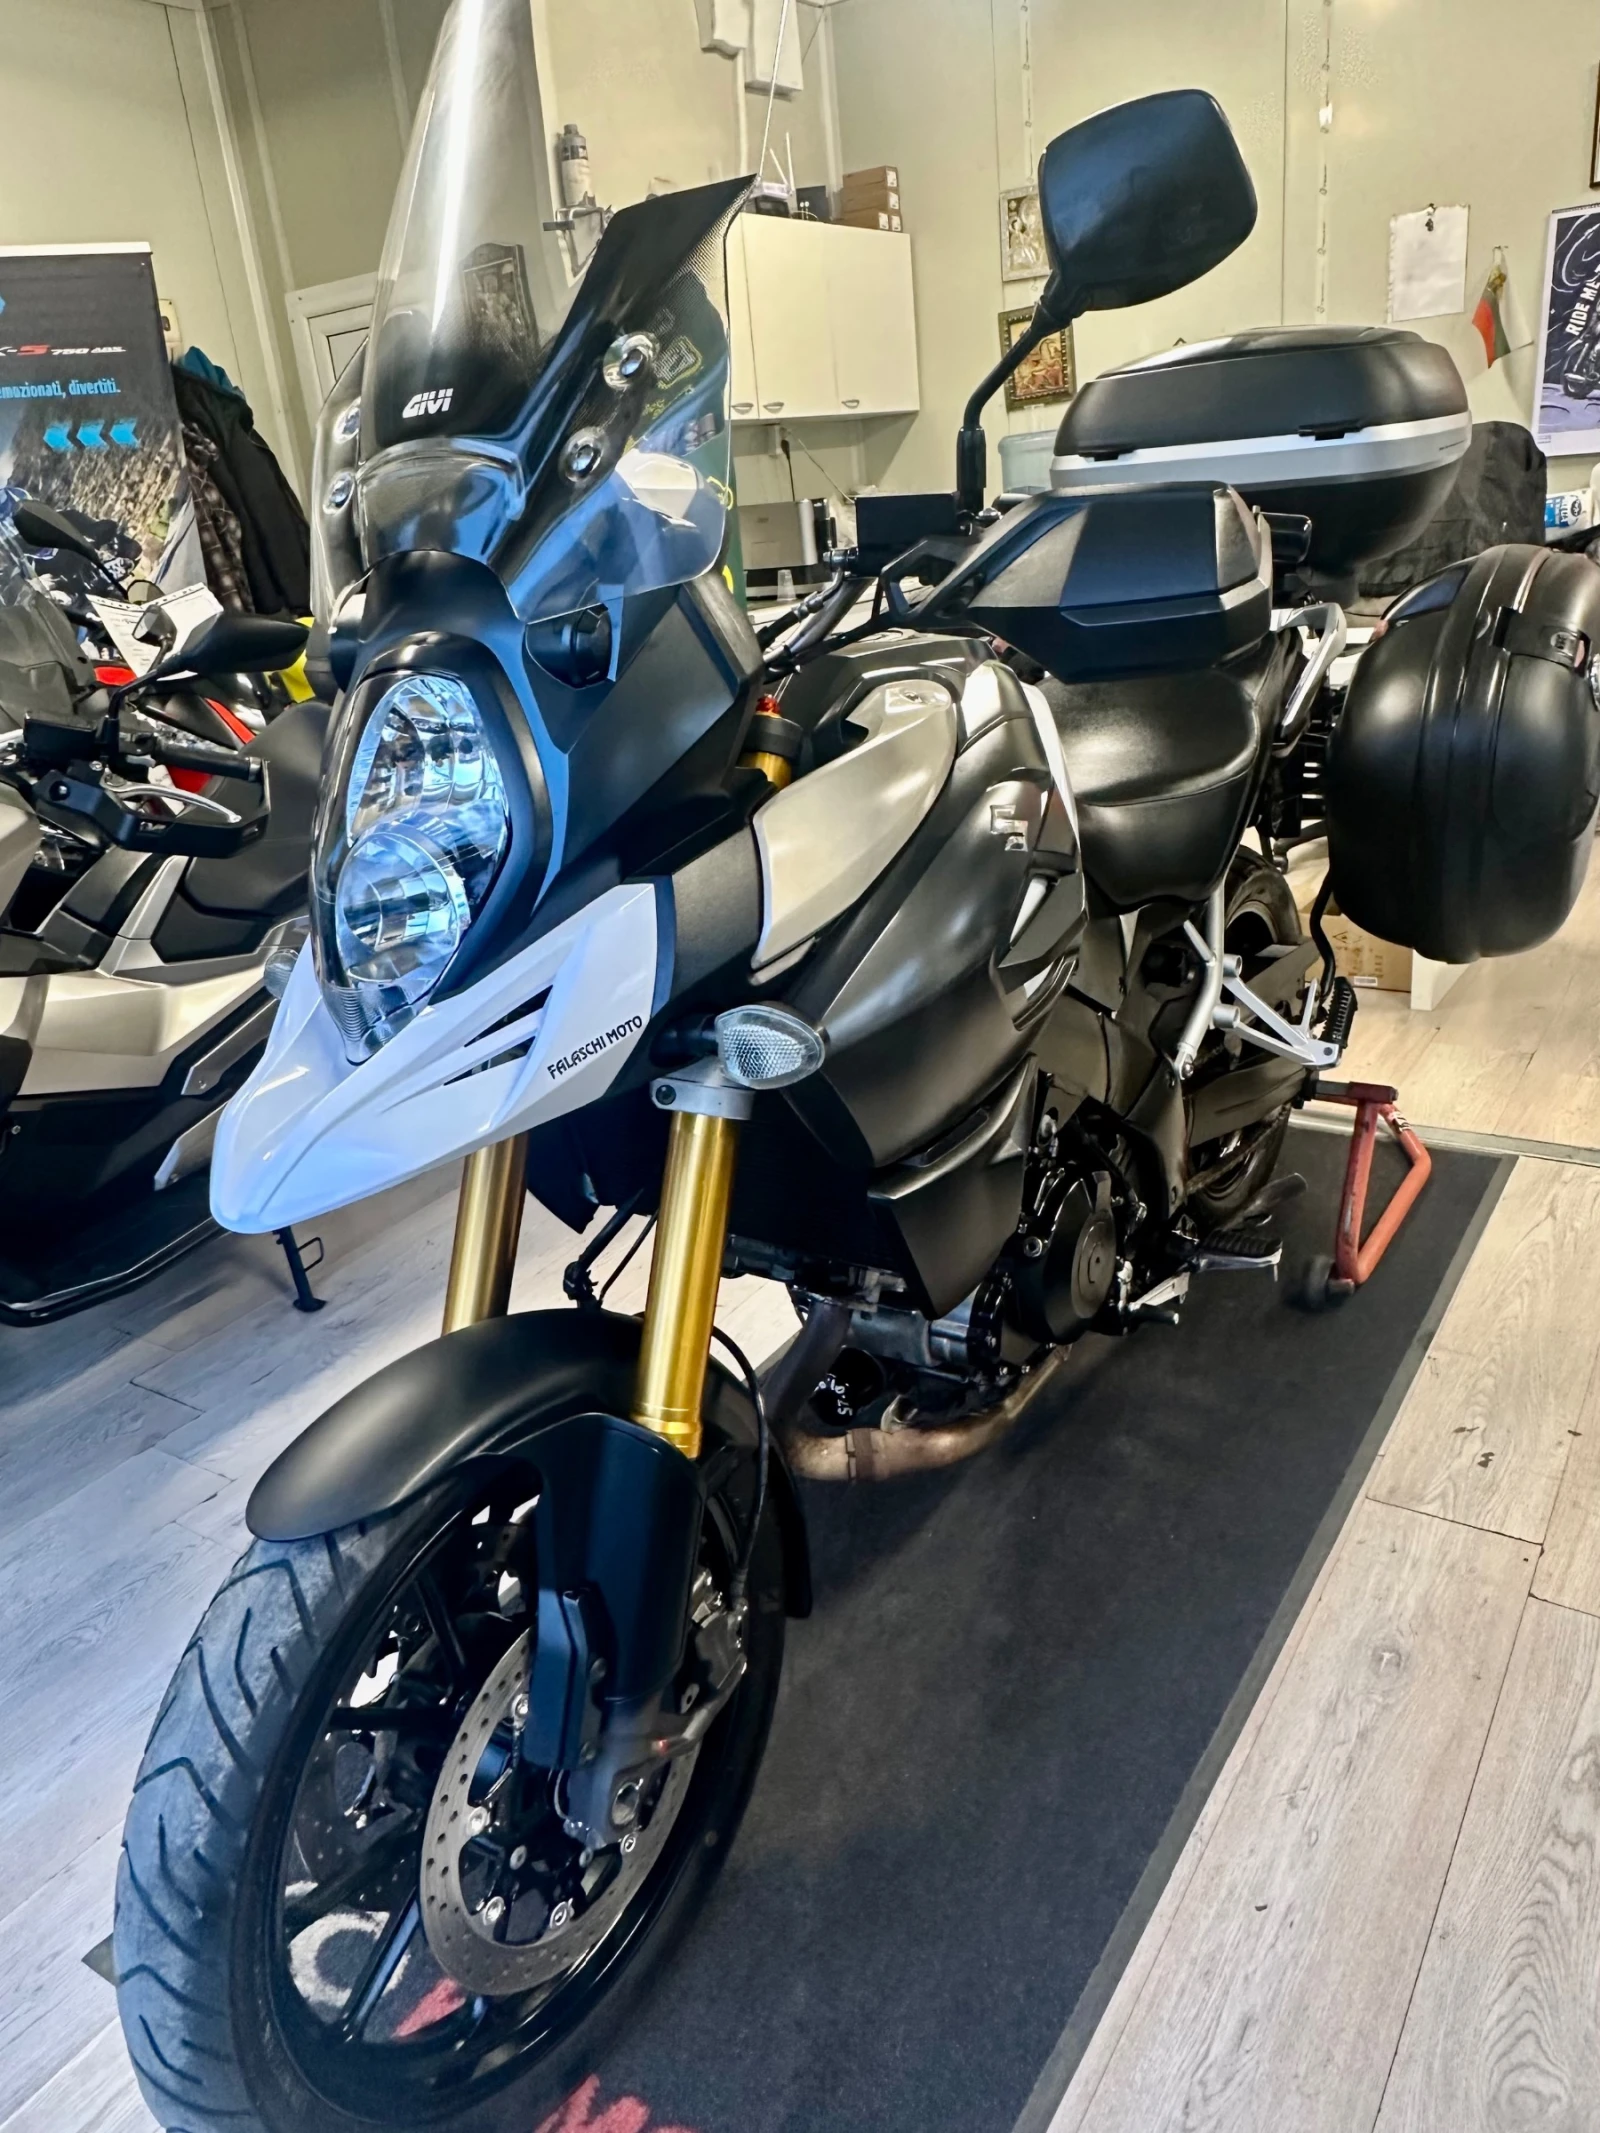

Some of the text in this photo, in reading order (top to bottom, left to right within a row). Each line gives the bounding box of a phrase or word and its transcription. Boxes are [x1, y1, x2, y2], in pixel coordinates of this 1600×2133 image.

[1565, 302, 1591, 336] RIDE
[51, 347, 90, 355] 750
[68, 377, 121, 396] divertiti.
[402, 387, 454, 419] GIVI
[547, 1015, 643, 1080] FALASCHI MOTO
